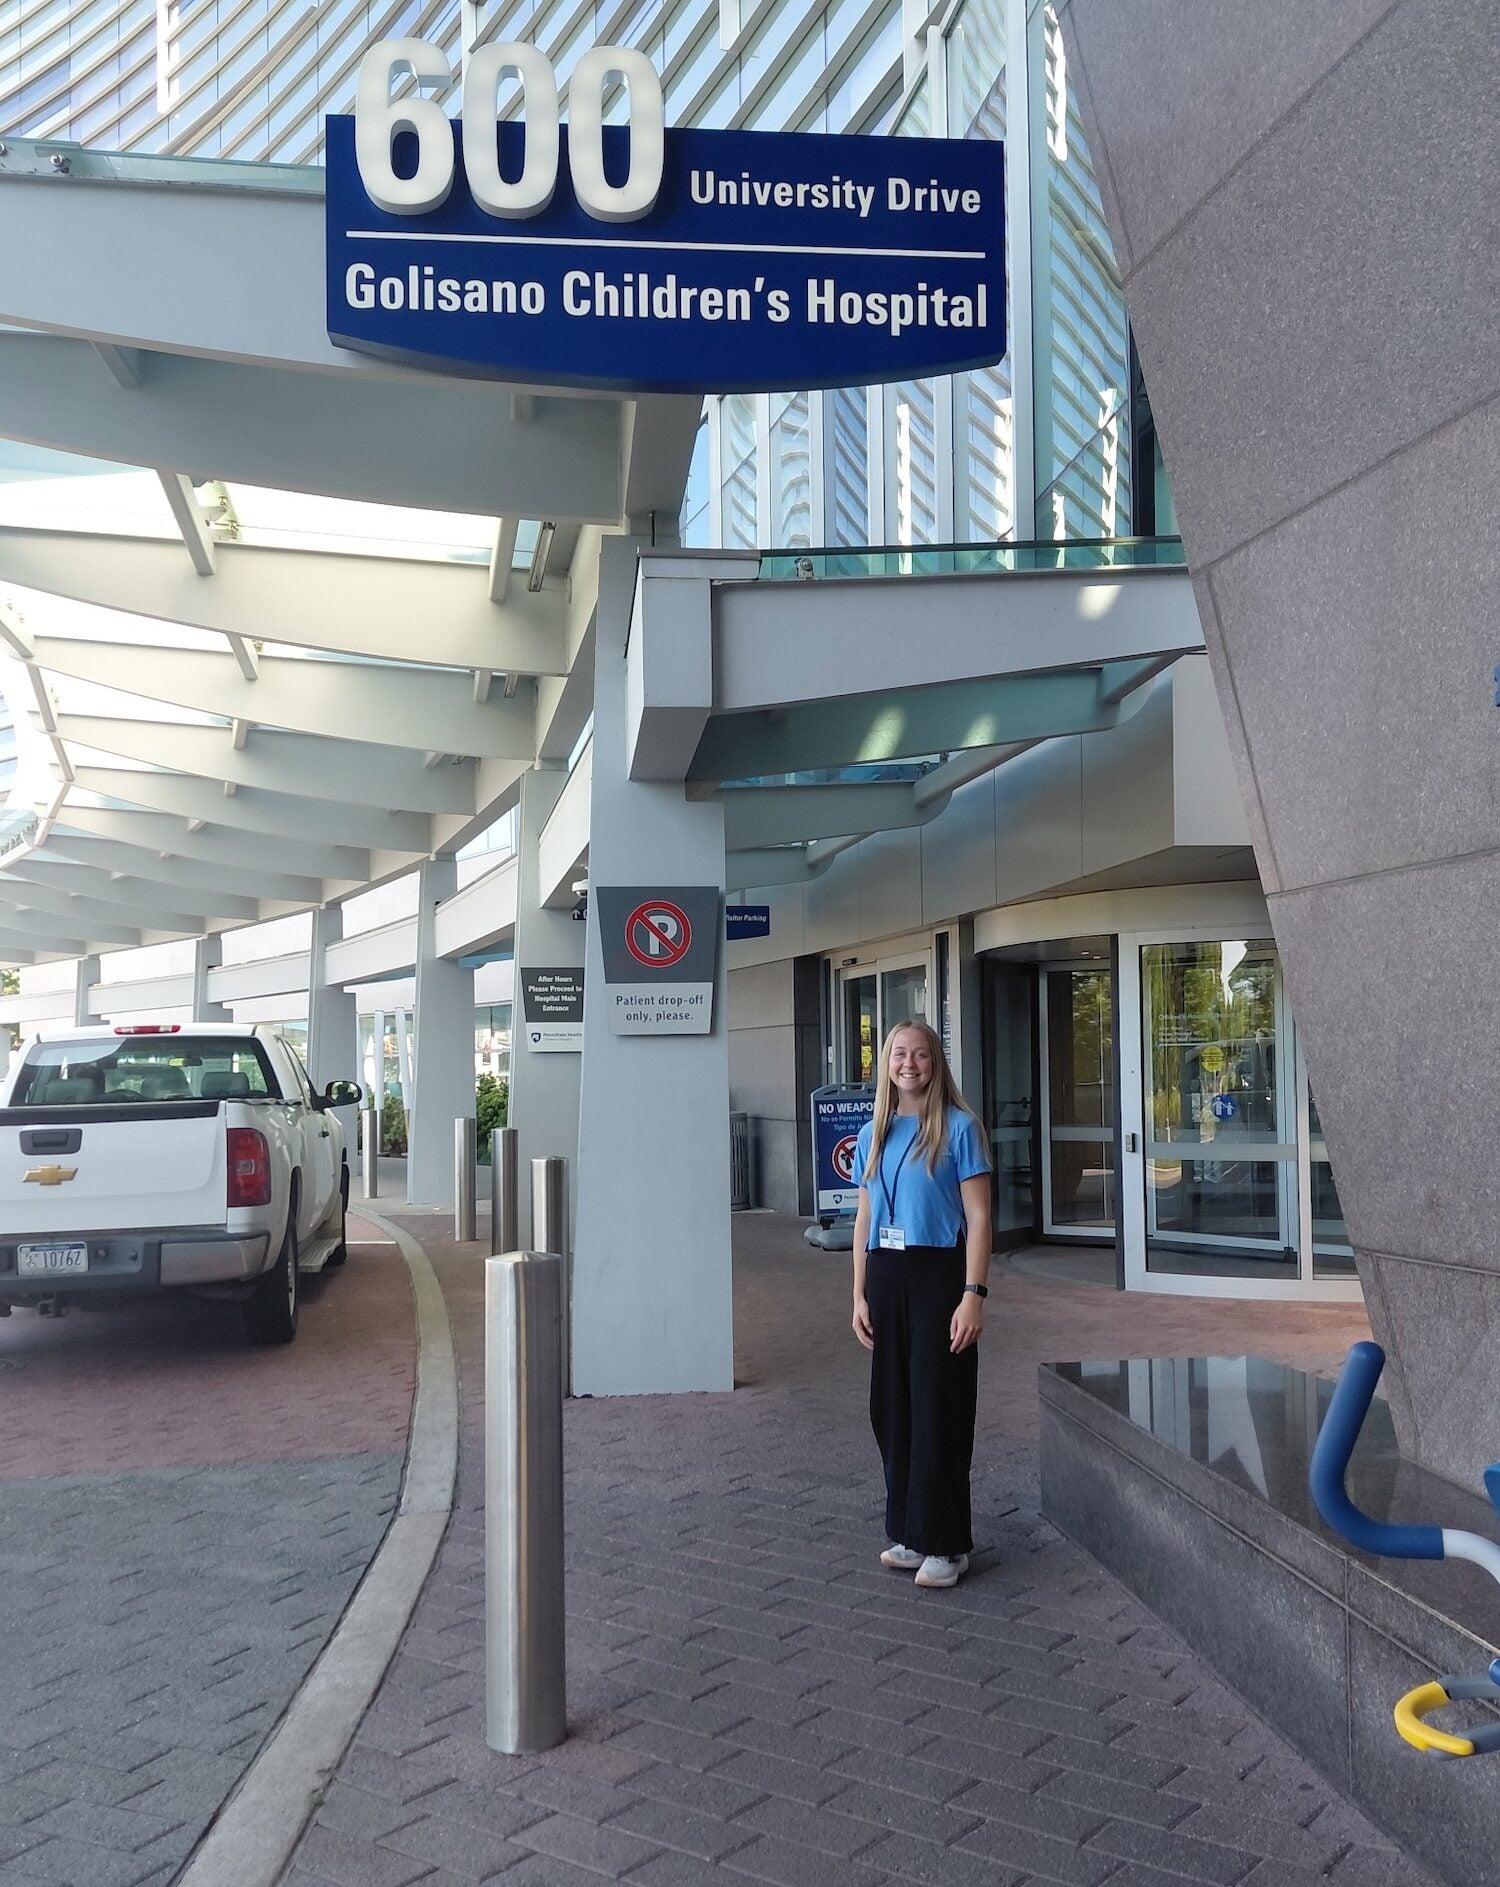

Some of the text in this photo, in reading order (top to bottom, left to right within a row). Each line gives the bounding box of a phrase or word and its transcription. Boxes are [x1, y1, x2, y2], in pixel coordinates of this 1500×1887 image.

[355, 37, 982, 223] 600 University Drive
[344, 262, 988, 336] Golisano Children's Hospital
[744, 914, 767, 922] Parking
[534, 995, 560, 1003] Hospital
[616, 994, 704, 1006] Patient drop-off
[626, 1010, 694, 1022] only, please.
[818, 1101, 874, 1114] NO WEAPO
[833, 1124, 847, 1132] Tipo
